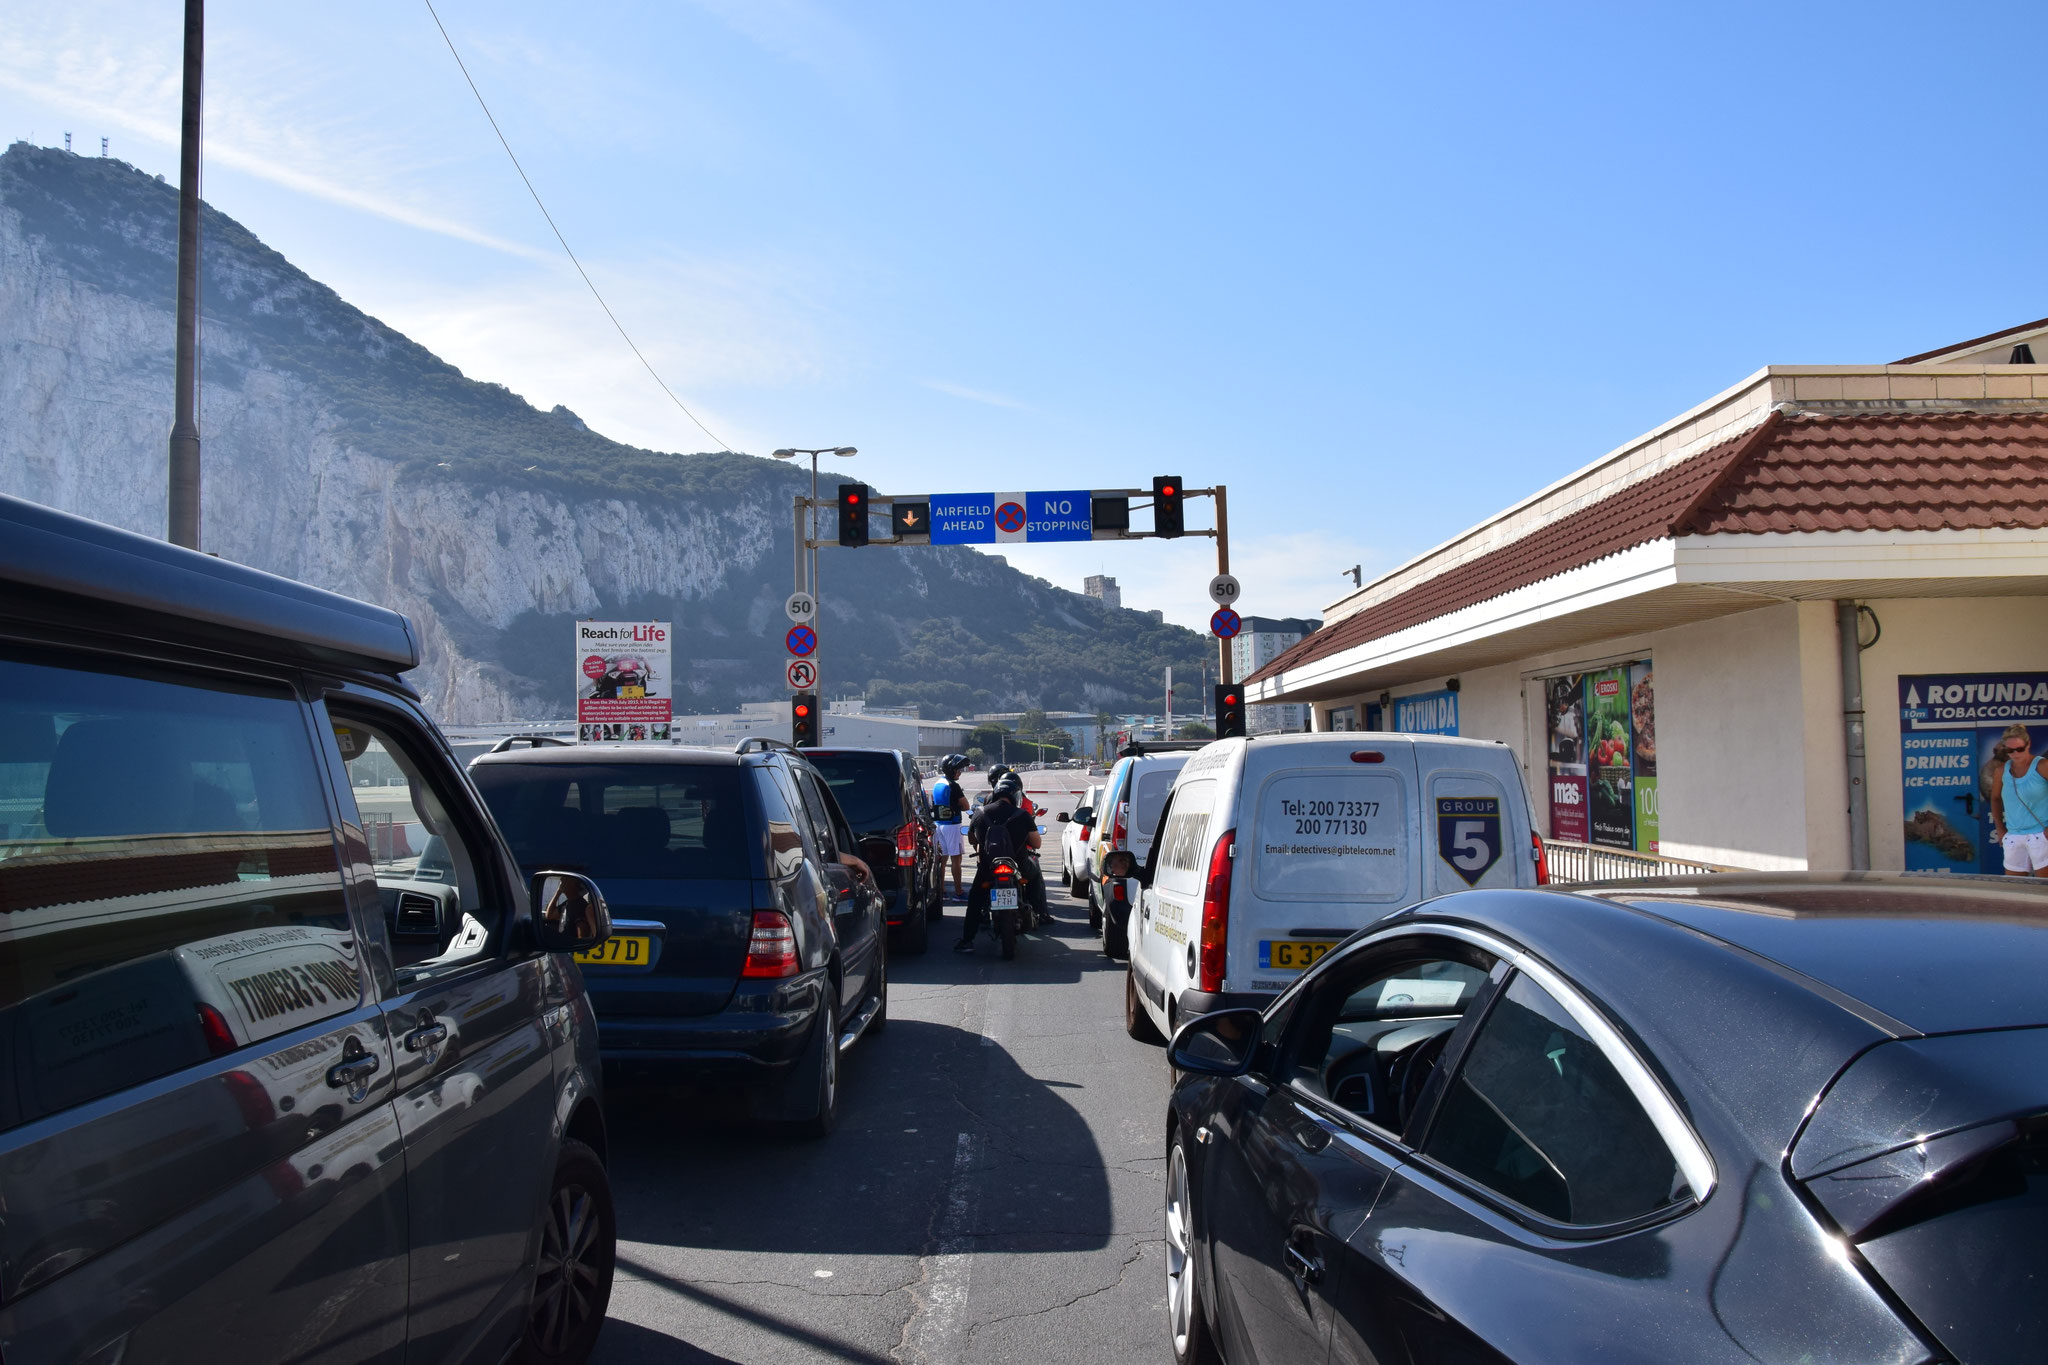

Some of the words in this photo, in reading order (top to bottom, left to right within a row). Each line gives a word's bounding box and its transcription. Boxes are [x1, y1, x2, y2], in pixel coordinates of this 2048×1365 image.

[935, 505, 991, 517] AIRFIELD
[1045, 500, 1072, 515] NO
[942, 520, 985, 531] AHEAD
[1027, 520, 1090, 532] STOPPING
[1216, 583, 1235, 596] 50
[792, 601, 811, 614] 50
[581, 627, 618, 639] Reach
[619, 627, 634, 641] for
[633, 625, 666, 642] Life
[1600, 683, 1618, 693] EROSKI
[1928, 682, 2048, 704] ROTUNDA
[1400, 696, 1456, 732] ROTUNDA
[1904, 710, 1926, 718] 10m
[1934, 704, 2047, 718] TOBACCONIST
[1904, 738, 1969, 749] SOUVENIRS
[1905, 755, 1970, 769] DRINKS
[1905, 776, 1971, 787] ICE-CREAM
[1554, 782, 1580, 805] mas
[1281, 800, 1306, 816] Tel:
[1309, 801, 1334, 816] 200
[1338, 801, 1380, 817] 73377
[1442, 801, 1494, 812] GROUP
[1295, 819, 1321, 834] 200
[1325, 819, 1367, 835] 77130
[1290, 845, 1396, 857] detectives@gibtelecom.net
[1452, 821, 1490, 871] 5
[996, 889, 1016, 898] 4494
[1279, 944, 1292, 965] G
